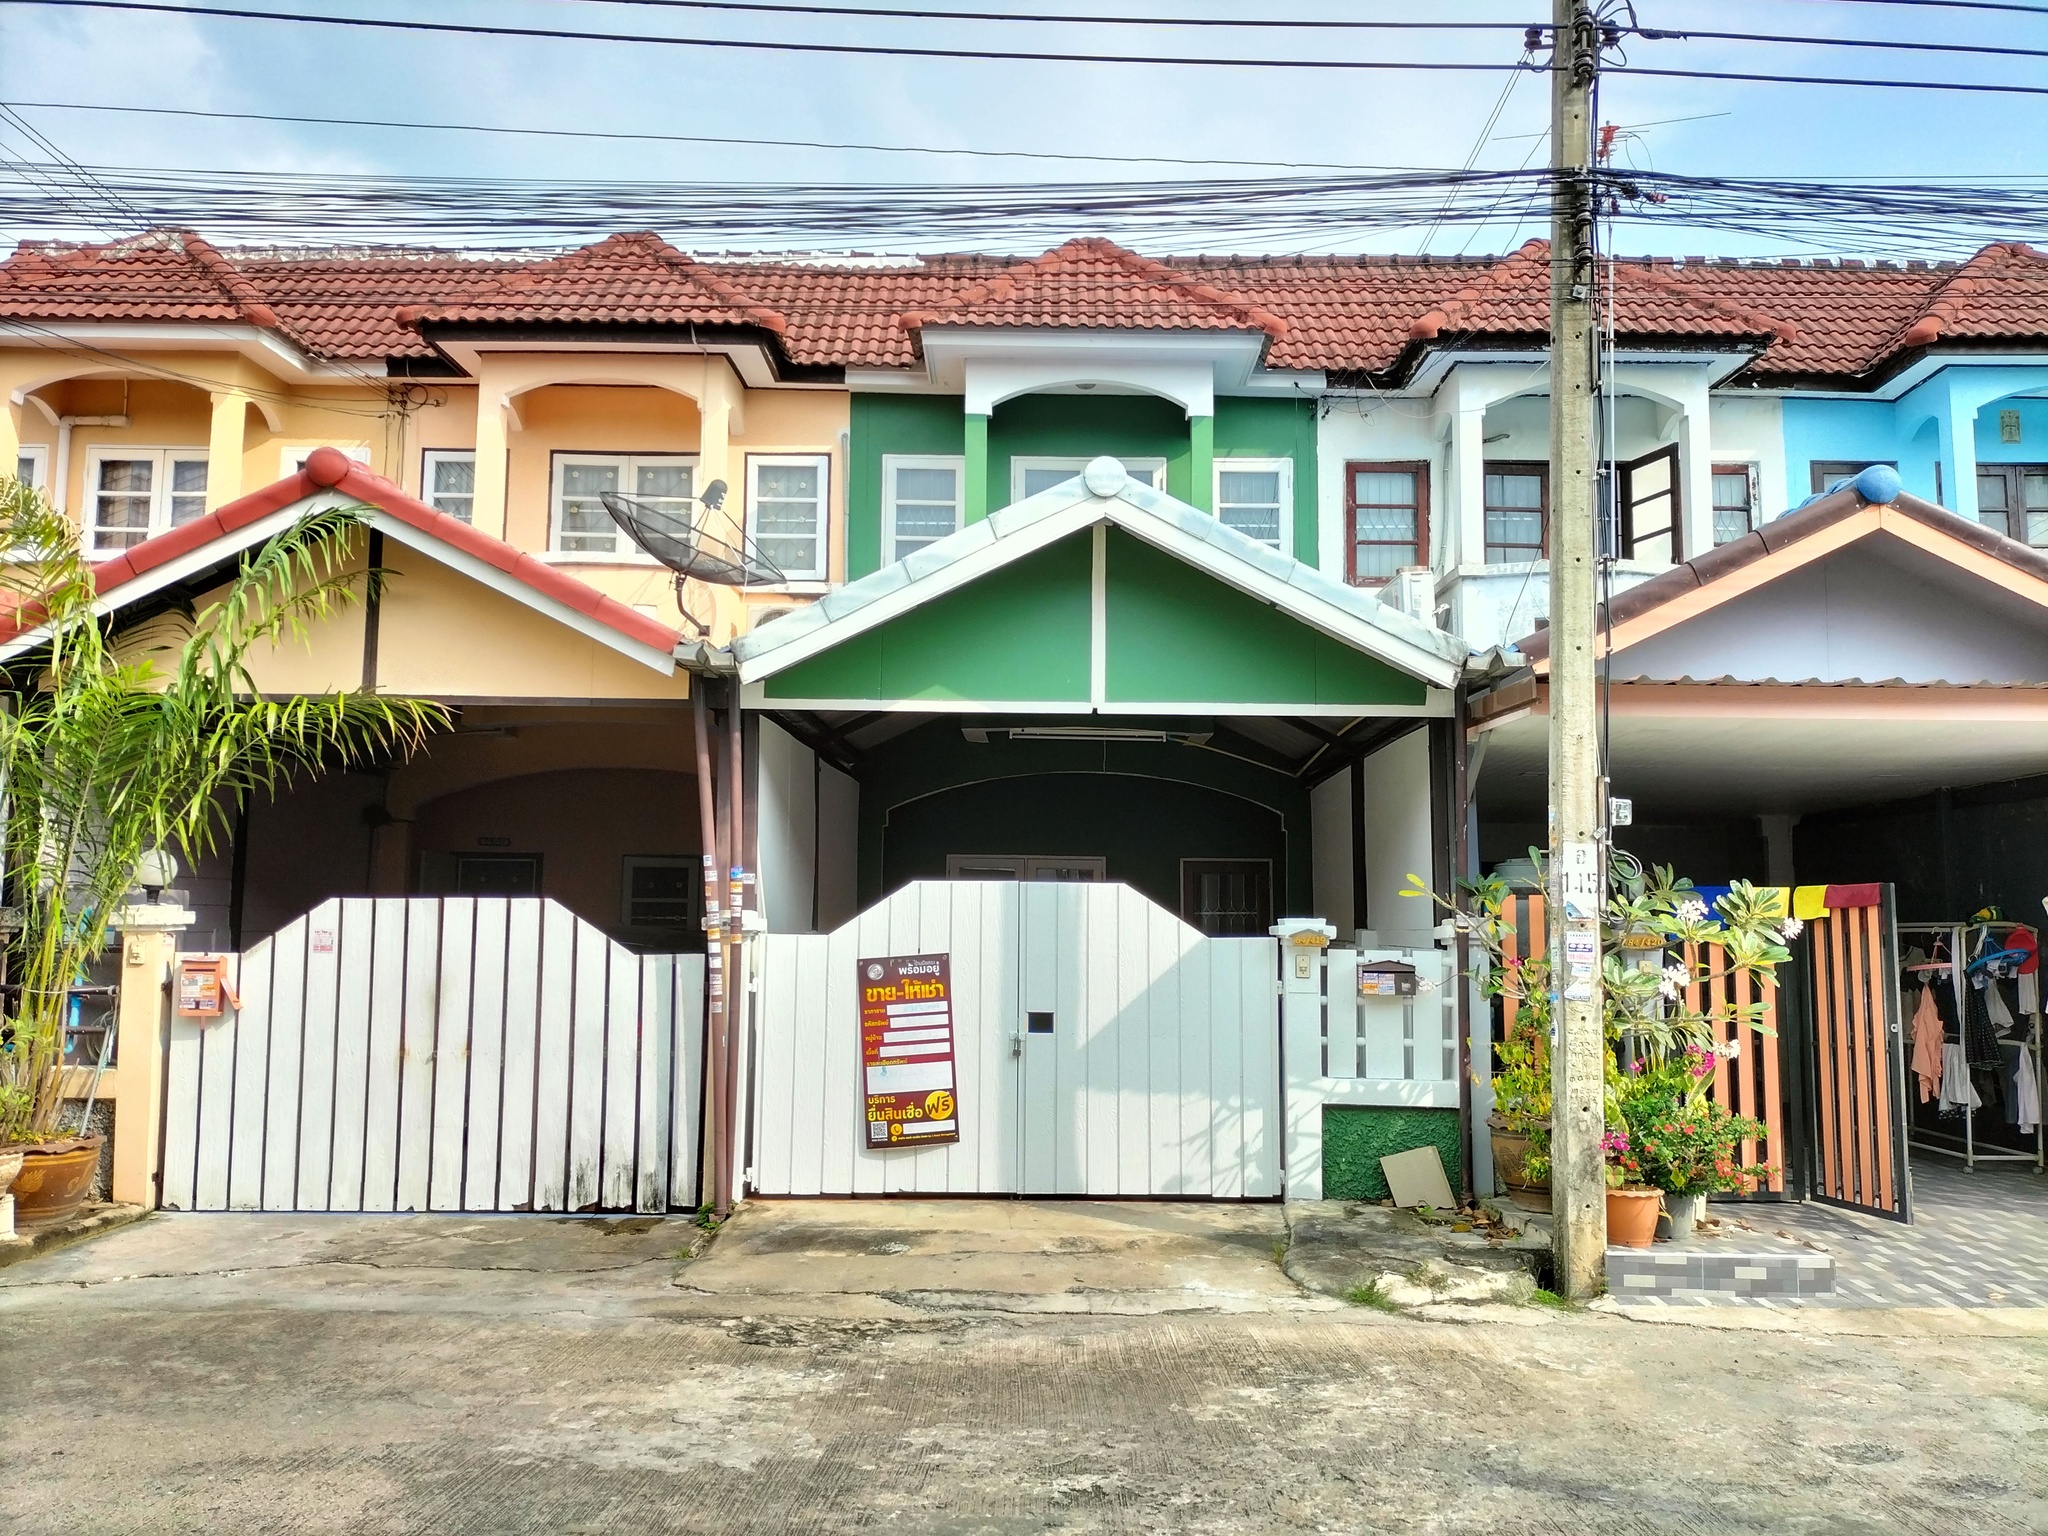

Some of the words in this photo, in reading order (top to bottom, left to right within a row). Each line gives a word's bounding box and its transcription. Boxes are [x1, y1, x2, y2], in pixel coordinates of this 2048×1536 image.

[898, 961, 940, 976] พร้อมอยู่
[866, 978, 944, 1002] ขาย-ให้เช่า
[868, 1095, 896, 1104] บริการ
[927, 1094, 951, 1116] ฟรี
[867, 1102, 923, 1121] ยื่นสินเชื่อ
